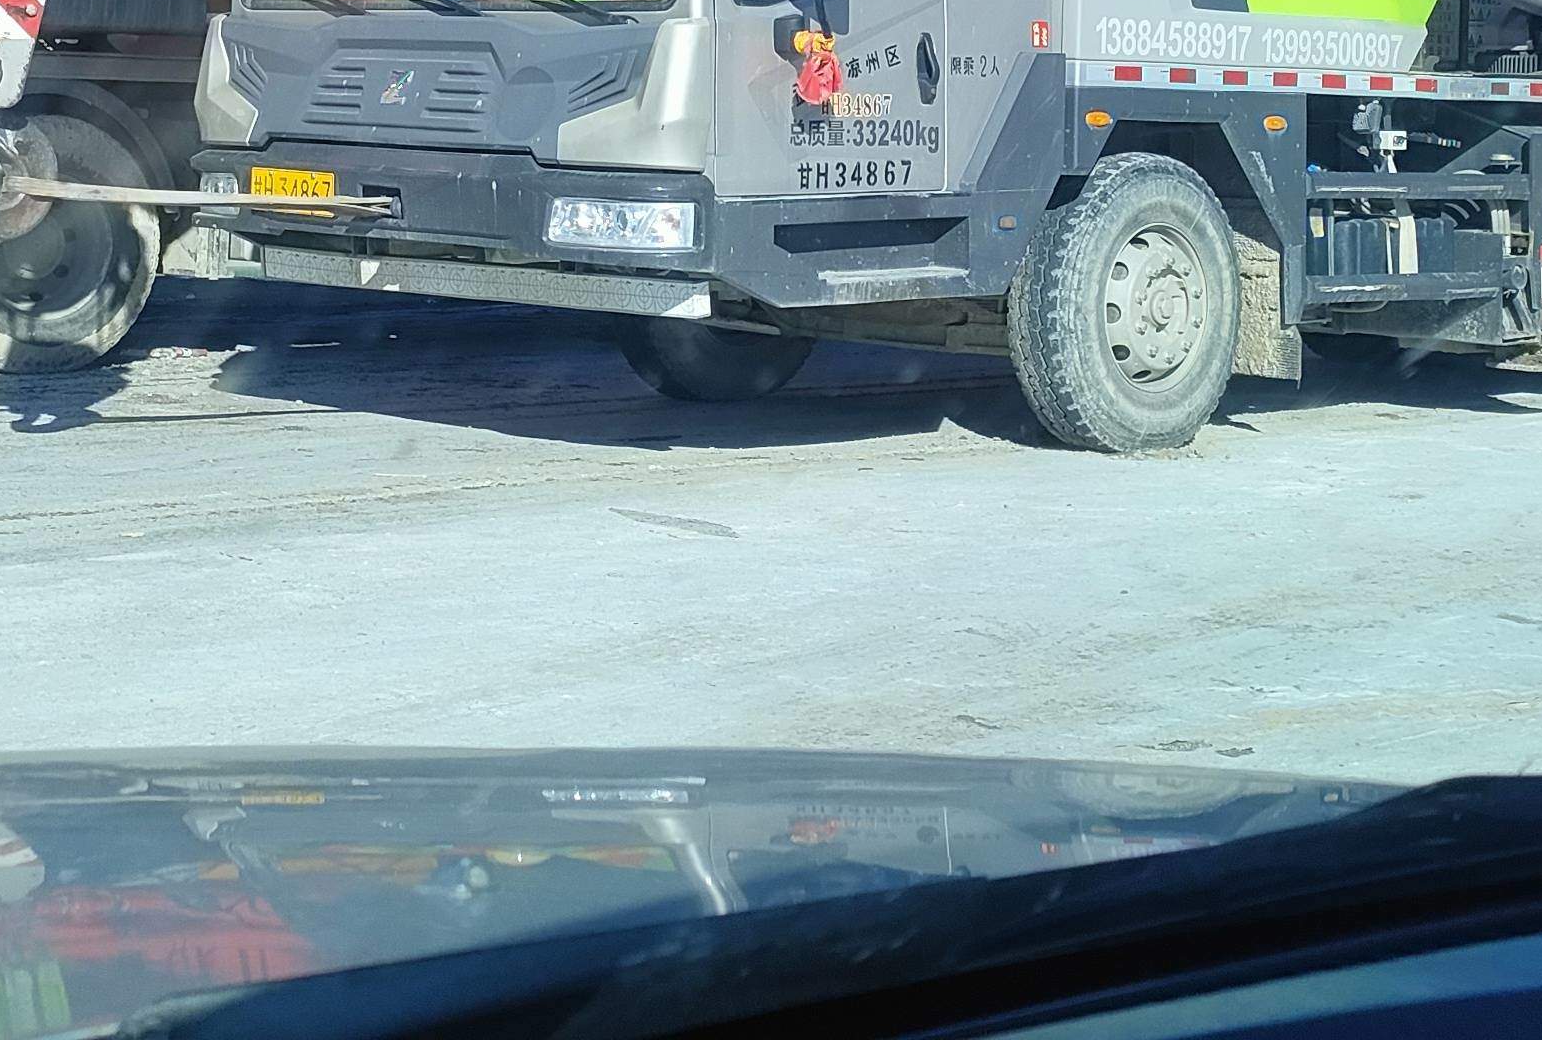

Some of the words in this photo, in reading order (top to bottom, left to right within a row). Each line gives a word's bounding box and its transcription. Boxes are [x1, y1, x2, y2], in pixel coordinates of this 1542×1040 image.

[1095, 16, 1252, 61] 13884588917
[1262, 27, 1404, 68] 13993500897
[797, 160, 912, 190] 甘H34867
